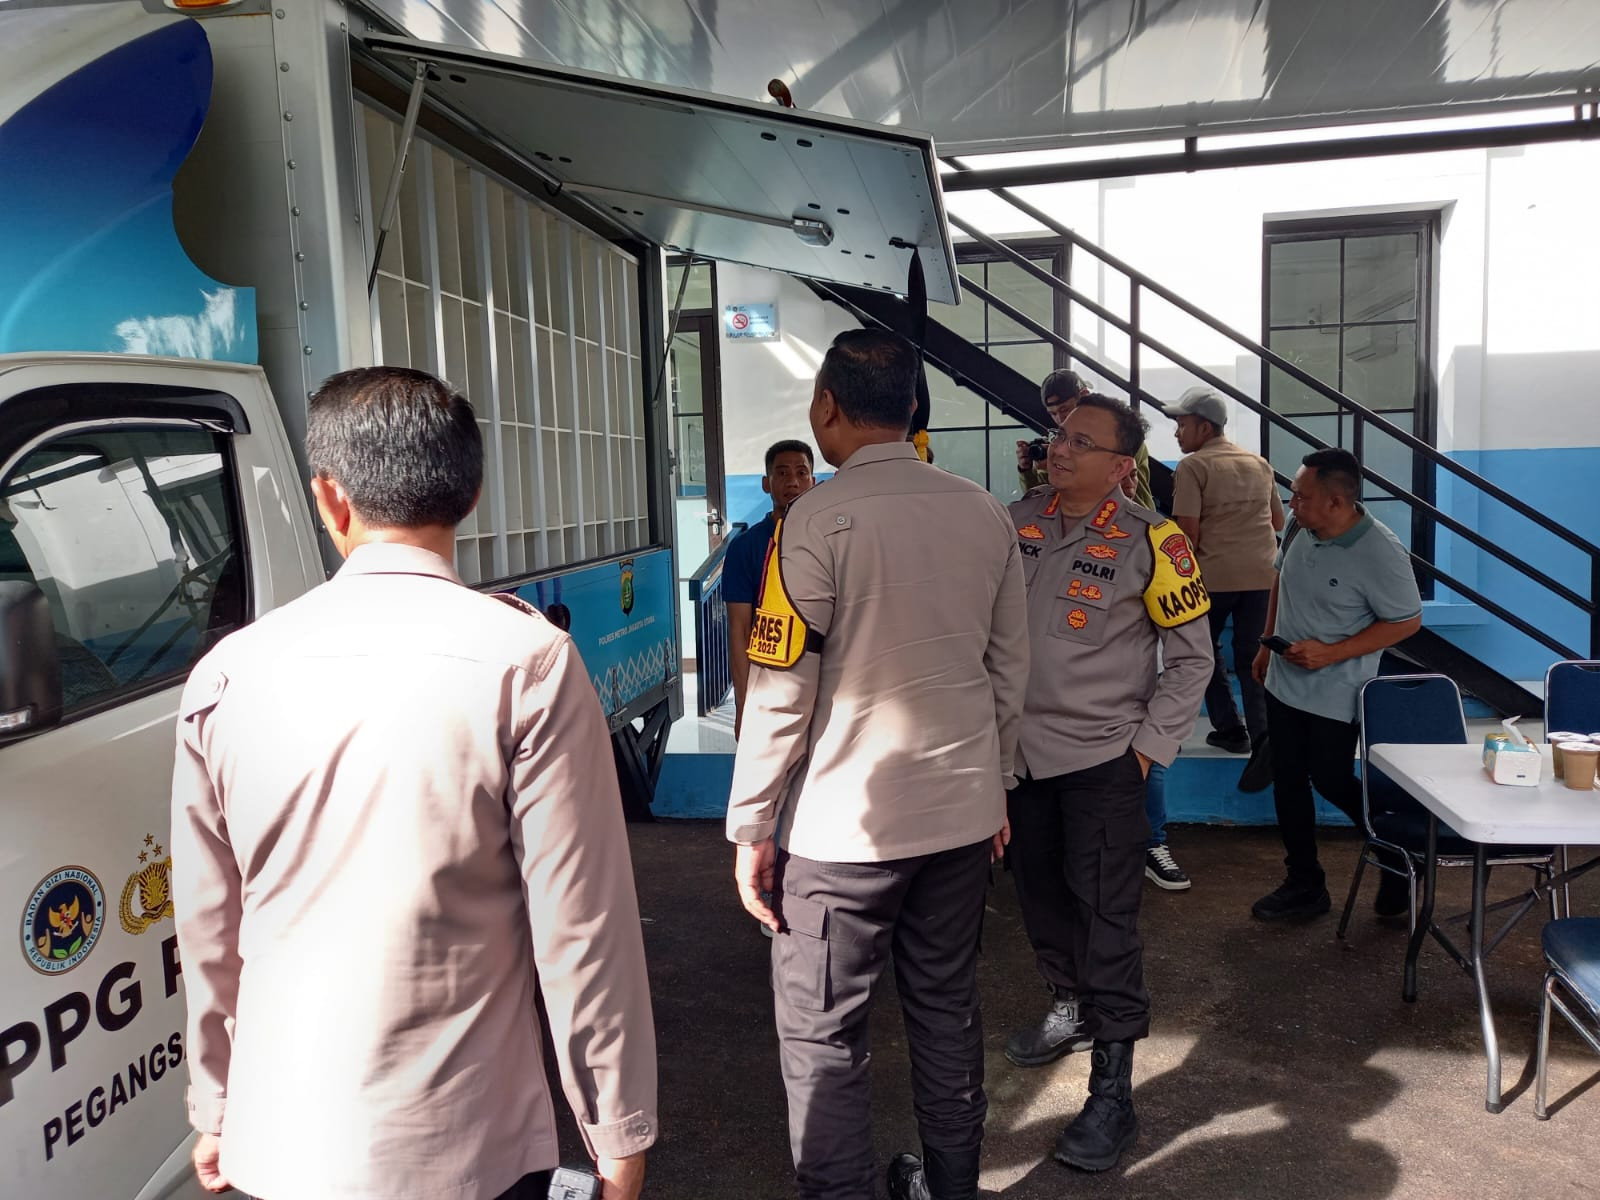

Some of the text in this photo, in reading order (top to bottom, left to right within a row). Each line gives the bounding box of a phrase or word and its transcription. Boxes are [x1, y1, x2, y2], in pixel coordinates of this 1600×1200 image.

[1072, 559, 1115, 581] POLRI
[757, 640, 778, 655] 2025
[26, 871, 98, 926] BADAN GIZI NASIONAL
[28, 916, 102, 970] REPUBLIK INDONESIA
[43, 1031, 187, 1161] PEGANGS
